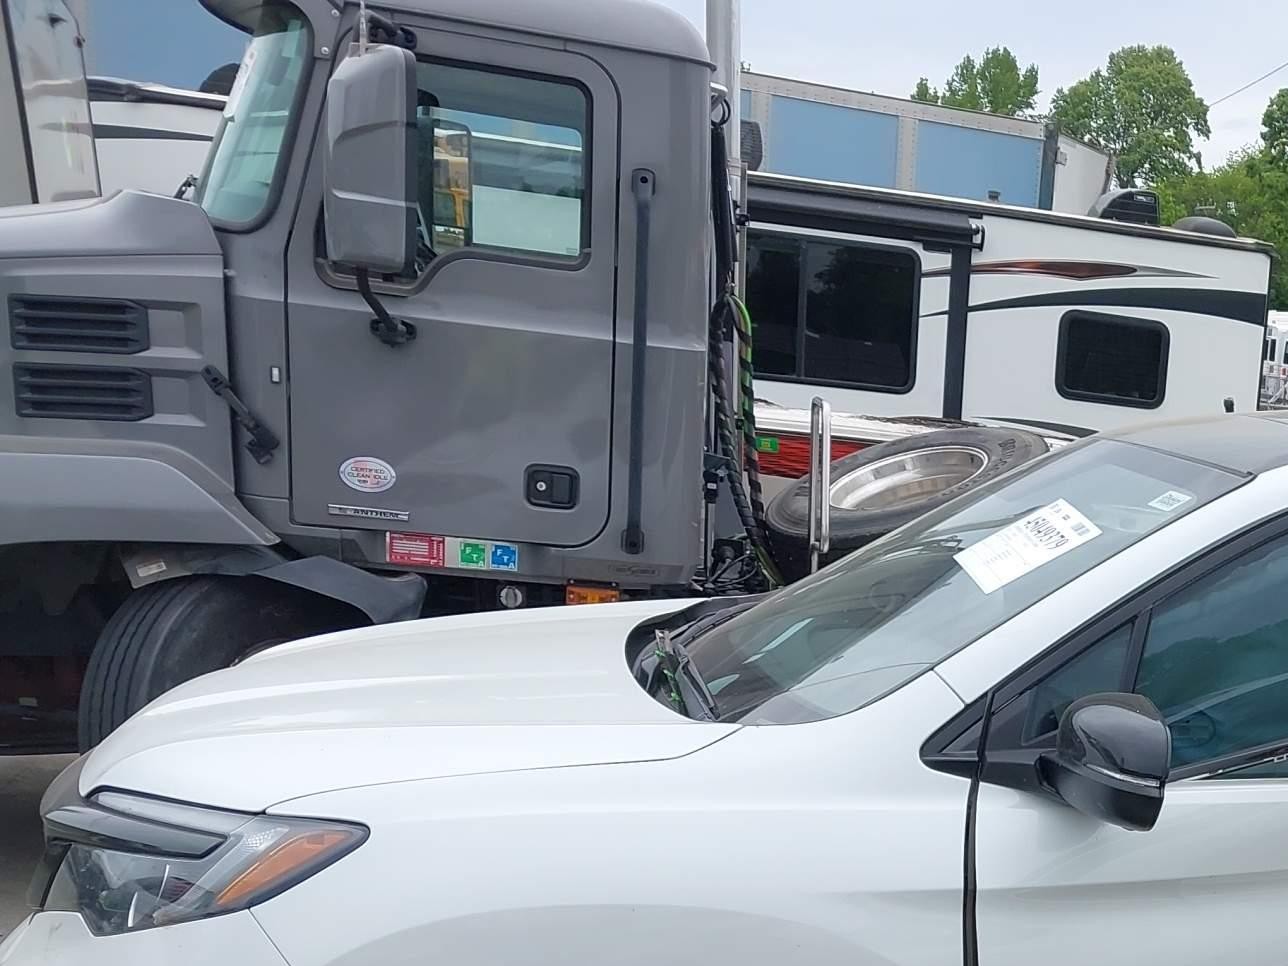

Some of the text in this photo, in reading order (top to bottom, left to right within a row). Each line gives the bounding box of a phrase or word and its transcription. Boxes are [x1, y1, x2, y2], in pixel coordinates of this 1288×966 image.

[347, 471, 371, 479] CLEAN
[350, 466, 385, 475] CERTIFIED
[1023, 516, 1070, 550] 45049379
